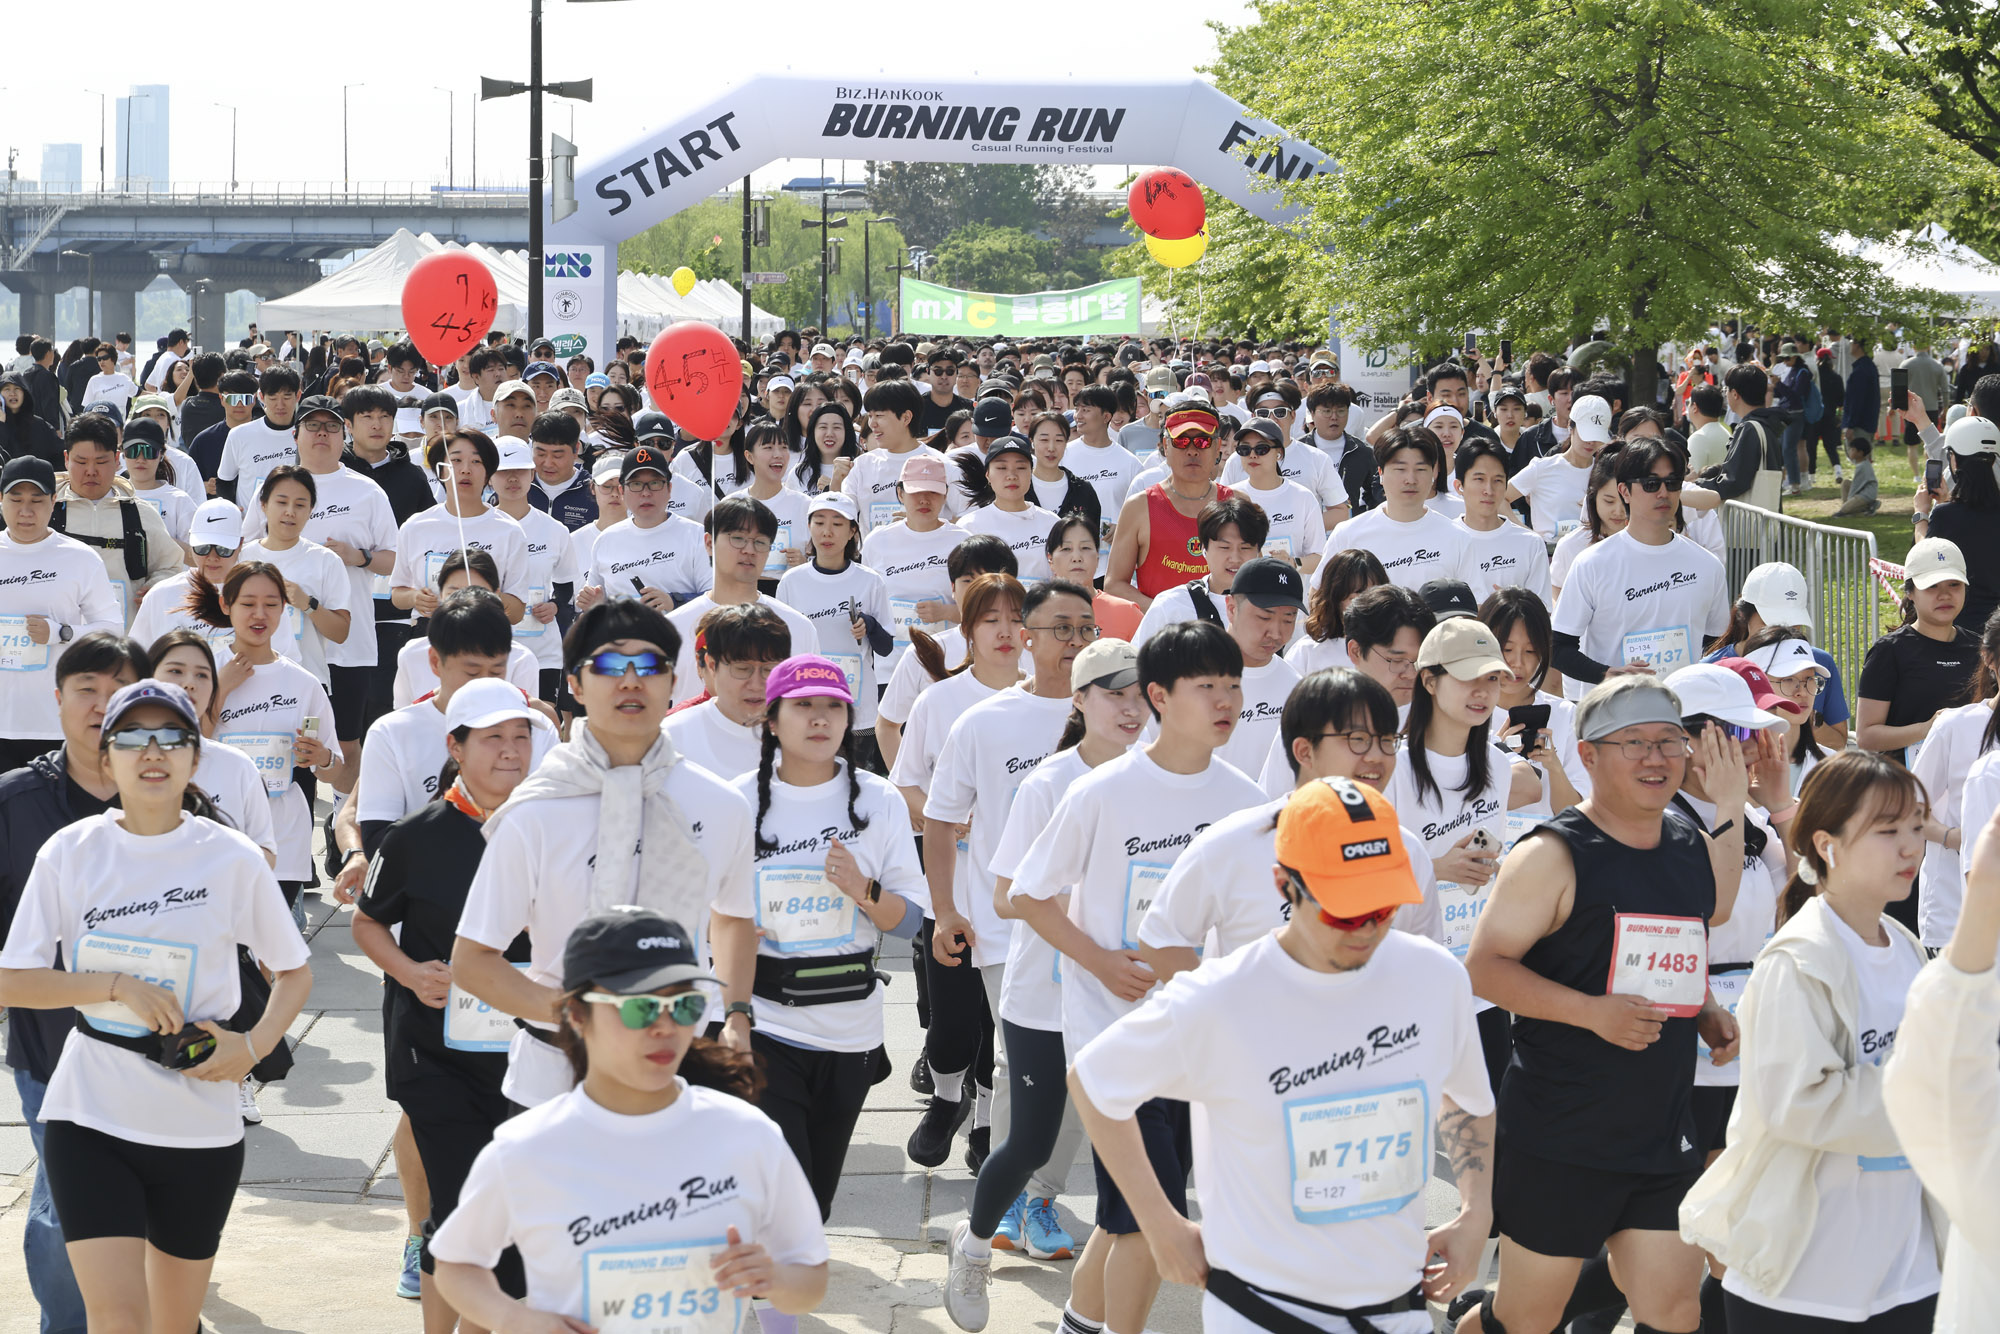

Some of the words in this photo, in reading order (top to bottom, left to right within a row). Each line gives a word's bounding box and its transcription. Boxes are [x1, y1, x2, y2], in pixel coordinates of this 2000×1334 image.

[821, 103, 1020, 141] BURNING
[1027, 107, 1126, 142] RUN
[971, 143, 1011, 152] Casual
[1015, 144, 1064, 154] Running
[1068, 144, 1113, 153] Festival
[1219, 120, 1327, 184] FINI
[595, 111, 741, 216] START
[545, 252, 592, 265] MONO
[555, 291, 578, 300] SUNBODY
[1373, 396, 1400, 404] Habitat
[253, 451, 284, 463] Burning
[284, 447, 297, 456] Ru
[1100, 469, 1118, 478] Run
[1282, 469, 1302, 478] Run
[871, 483, 897, 494] Burni
[326, 504, 351, 515] Run
[667, 500, 686, 510] Run
[1272, 513, 1295, 524] Run
[528, 543, 547, 553] Run
[611, 558, 650, 574] Burning
[651, 551, 676, 563] Run
[1414, 549, 1441, 562] Run
[1491, 555, 1517, 568] Run
[30, 569, 58, 581] Run
[885, 561, 927, 577] Burning
[1278, 573, 1288, 585] NY
[1625, 579, 1671, 602] Burning
[1670, 571, 1698, 586] Run
[838, 600, 863, 613] Rn
[893, 617, 903, 625] W
[1625, 634, 1653, 645] BURNING
[1652, 633, 1666, 641] RUN
[1629, 644, 1651, 653] D-134
[1643, 648, 1683, 665] 7137
[795, 667, 840, 683] HOKA
[220, 701, 271, 723] Burning
[270, 694, 298, 708] Run
[1255, 702, 1283, 718] Run
[250, 756, 285, 770] 559
[1421, 811, 1473, 841] Burning
[1472, 798, 1500, 818] Run
[1507, 819, 1524, 828] RUN
[820, 826, 861, 845] Run
[1124, 833, 1193, 856] Burning
[1343, 840, 1388, 858] OAKLEY
[765, 873, 804, 882] BURNING
[804, 873, 824, 882] RUN
[163, 887, 209, 907] Run
[768, 900, 783, 913] W
[785, 896, 845, 915] 8484
[1136, 899, 1153, 911] M
[1626, 923, 1664, 934] BURNING
[1664, 926, 1682, 936] RUN
[85, 939, 130, 953] BURNING
[132, 945, 153, 956] RUN
[168, 951, 186, 961] 7km
[1625, 953, 1641, 967] M
[1647, 951, 1699, 974] 1483
[458, 998, 474, 1010] W
[1268, 1046, 1367, 1095] Burning
[1366, 1023, 1420, 1056] Run
[1299, 1104, 1353, 1123] BURNING
[1354, 1101, 1380, 1113] RUN
[1397, 1097, 1418, 1107] 7km
[1309, 1149, 1328, 1168] M
[1334, 1131, 1413, 1168] 7175
[1304, 1186, 1346, 1199] E-127
[568, 1197, 680, 1246] Burning
[679, 1176, 738, 1208] Run
[599, 1257, 659, 1271] BURNING
[660, 1255, 689, 1267] RUN
[603, 1299, 625, 1317] W
[631, 1286, 721, 1320] 8153
